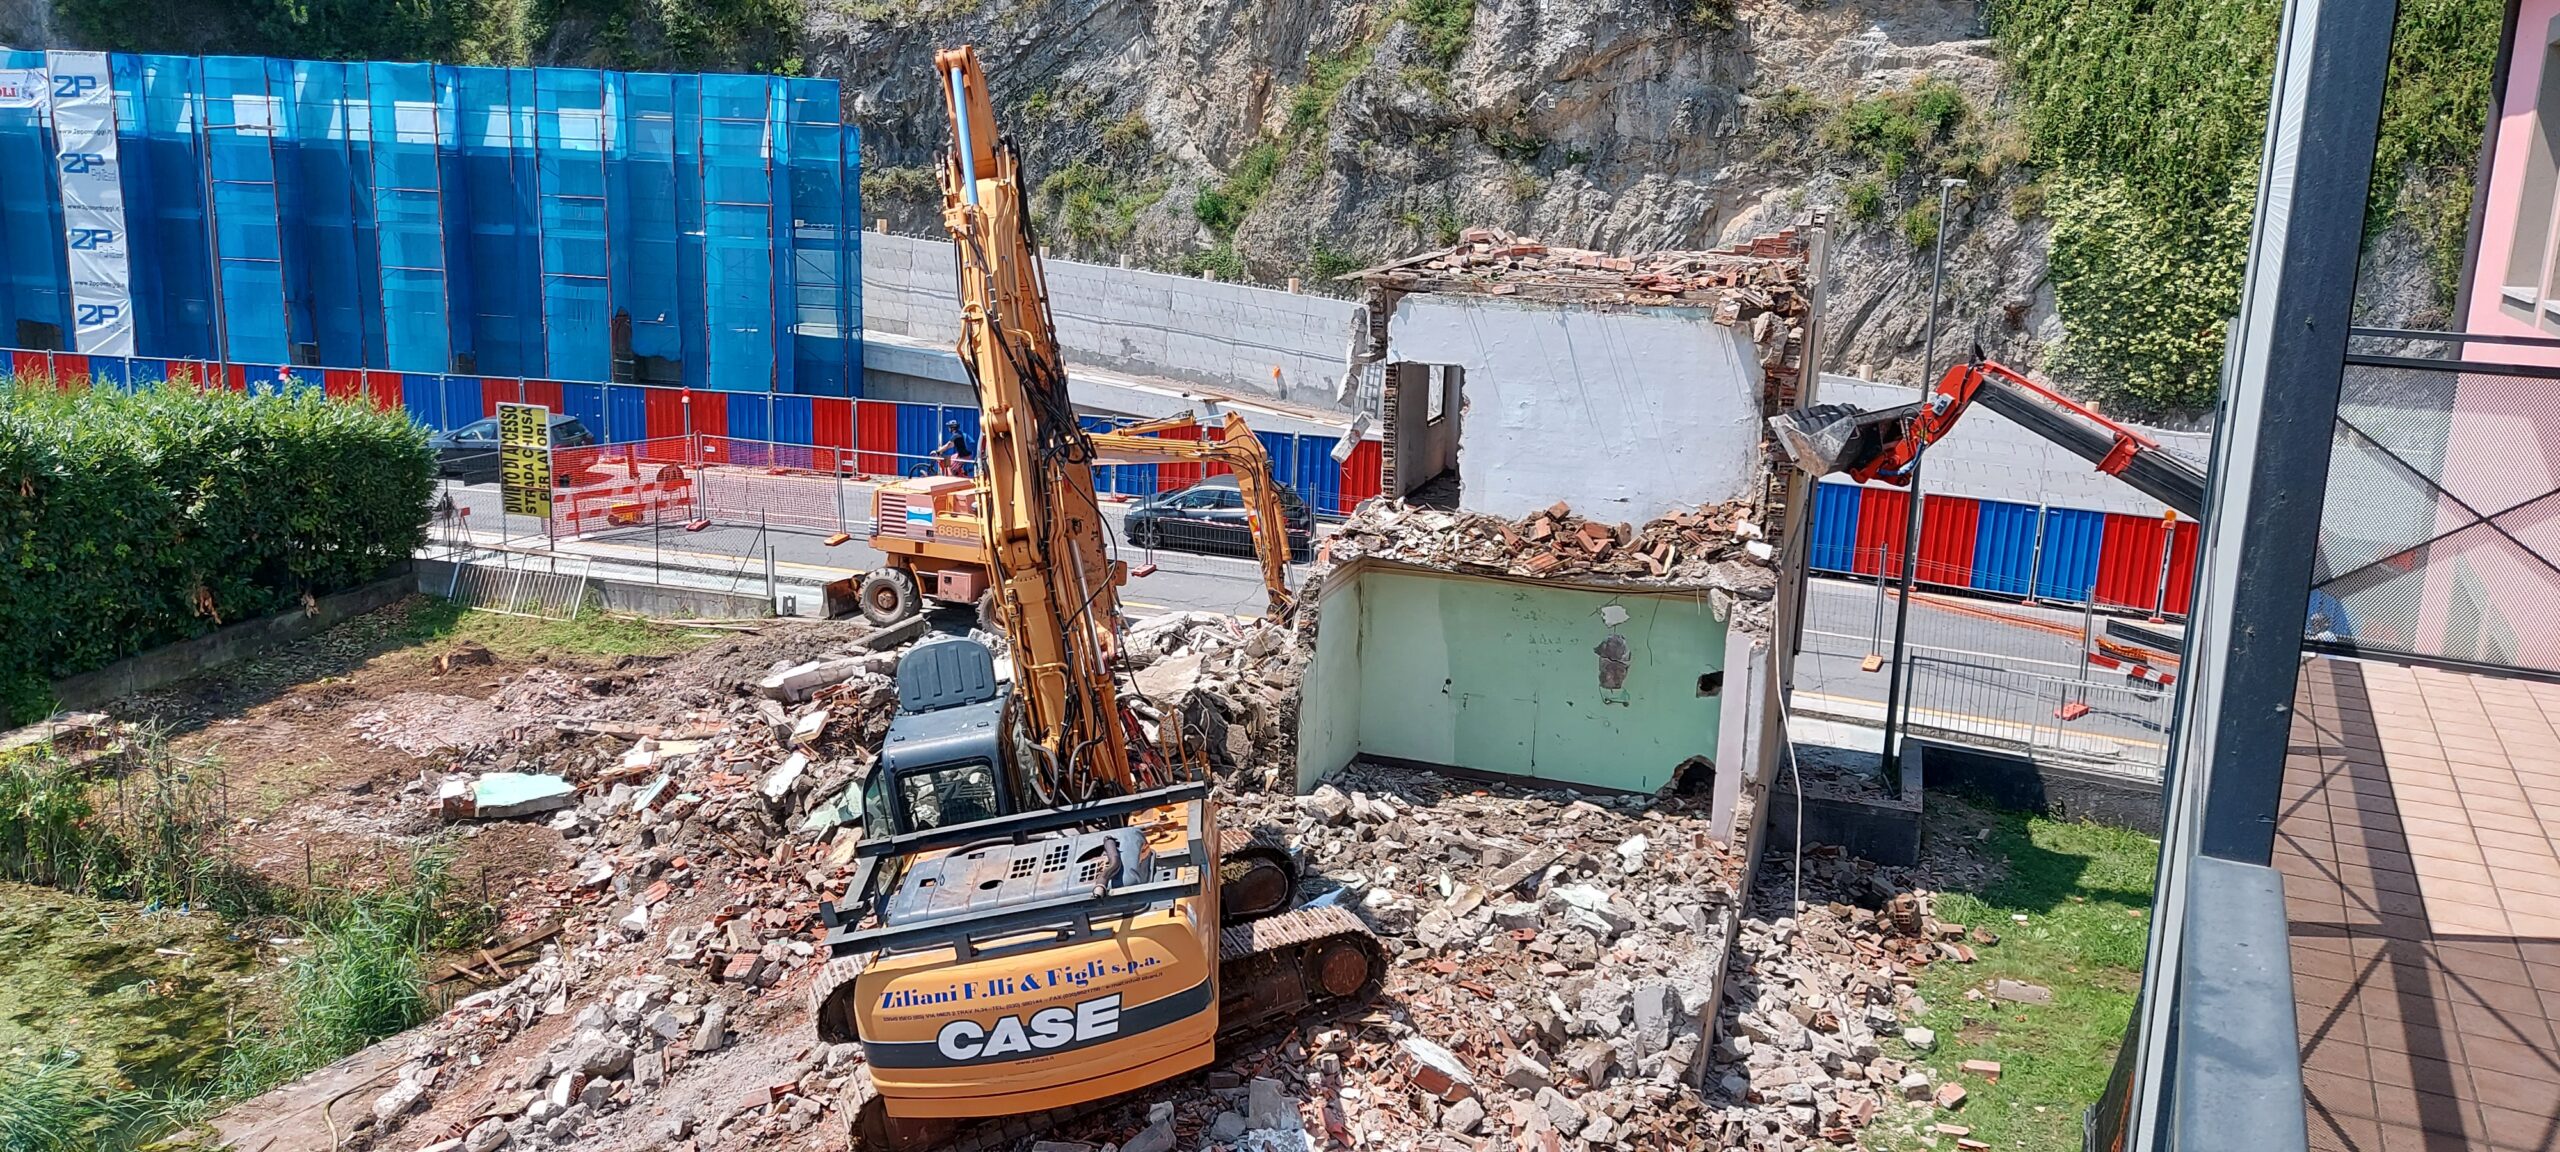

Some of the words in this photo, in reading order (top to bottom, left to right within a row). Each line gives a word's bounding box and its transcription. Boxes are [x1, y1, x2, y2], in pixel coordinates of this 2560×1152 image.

[53, 75, 97, 98] 2P
[60, 153, 105, 174] 2P
[71, 228, 113, 250] 2P
[77, 303, 120, 326] 2P
[503, 458, 520, 470] DI
[524, 463, 537, 514] STRADA
[938, 525, 969, 539] 688B
[880, 984, 958, 1009] Ziliani
[1020, 973, 1043, 993] &
[1046, 959, 1105, 988] Figli
[1111, 956, 1161, 974] s.p.a.
[937, 993, 1121, 1061] CASE
